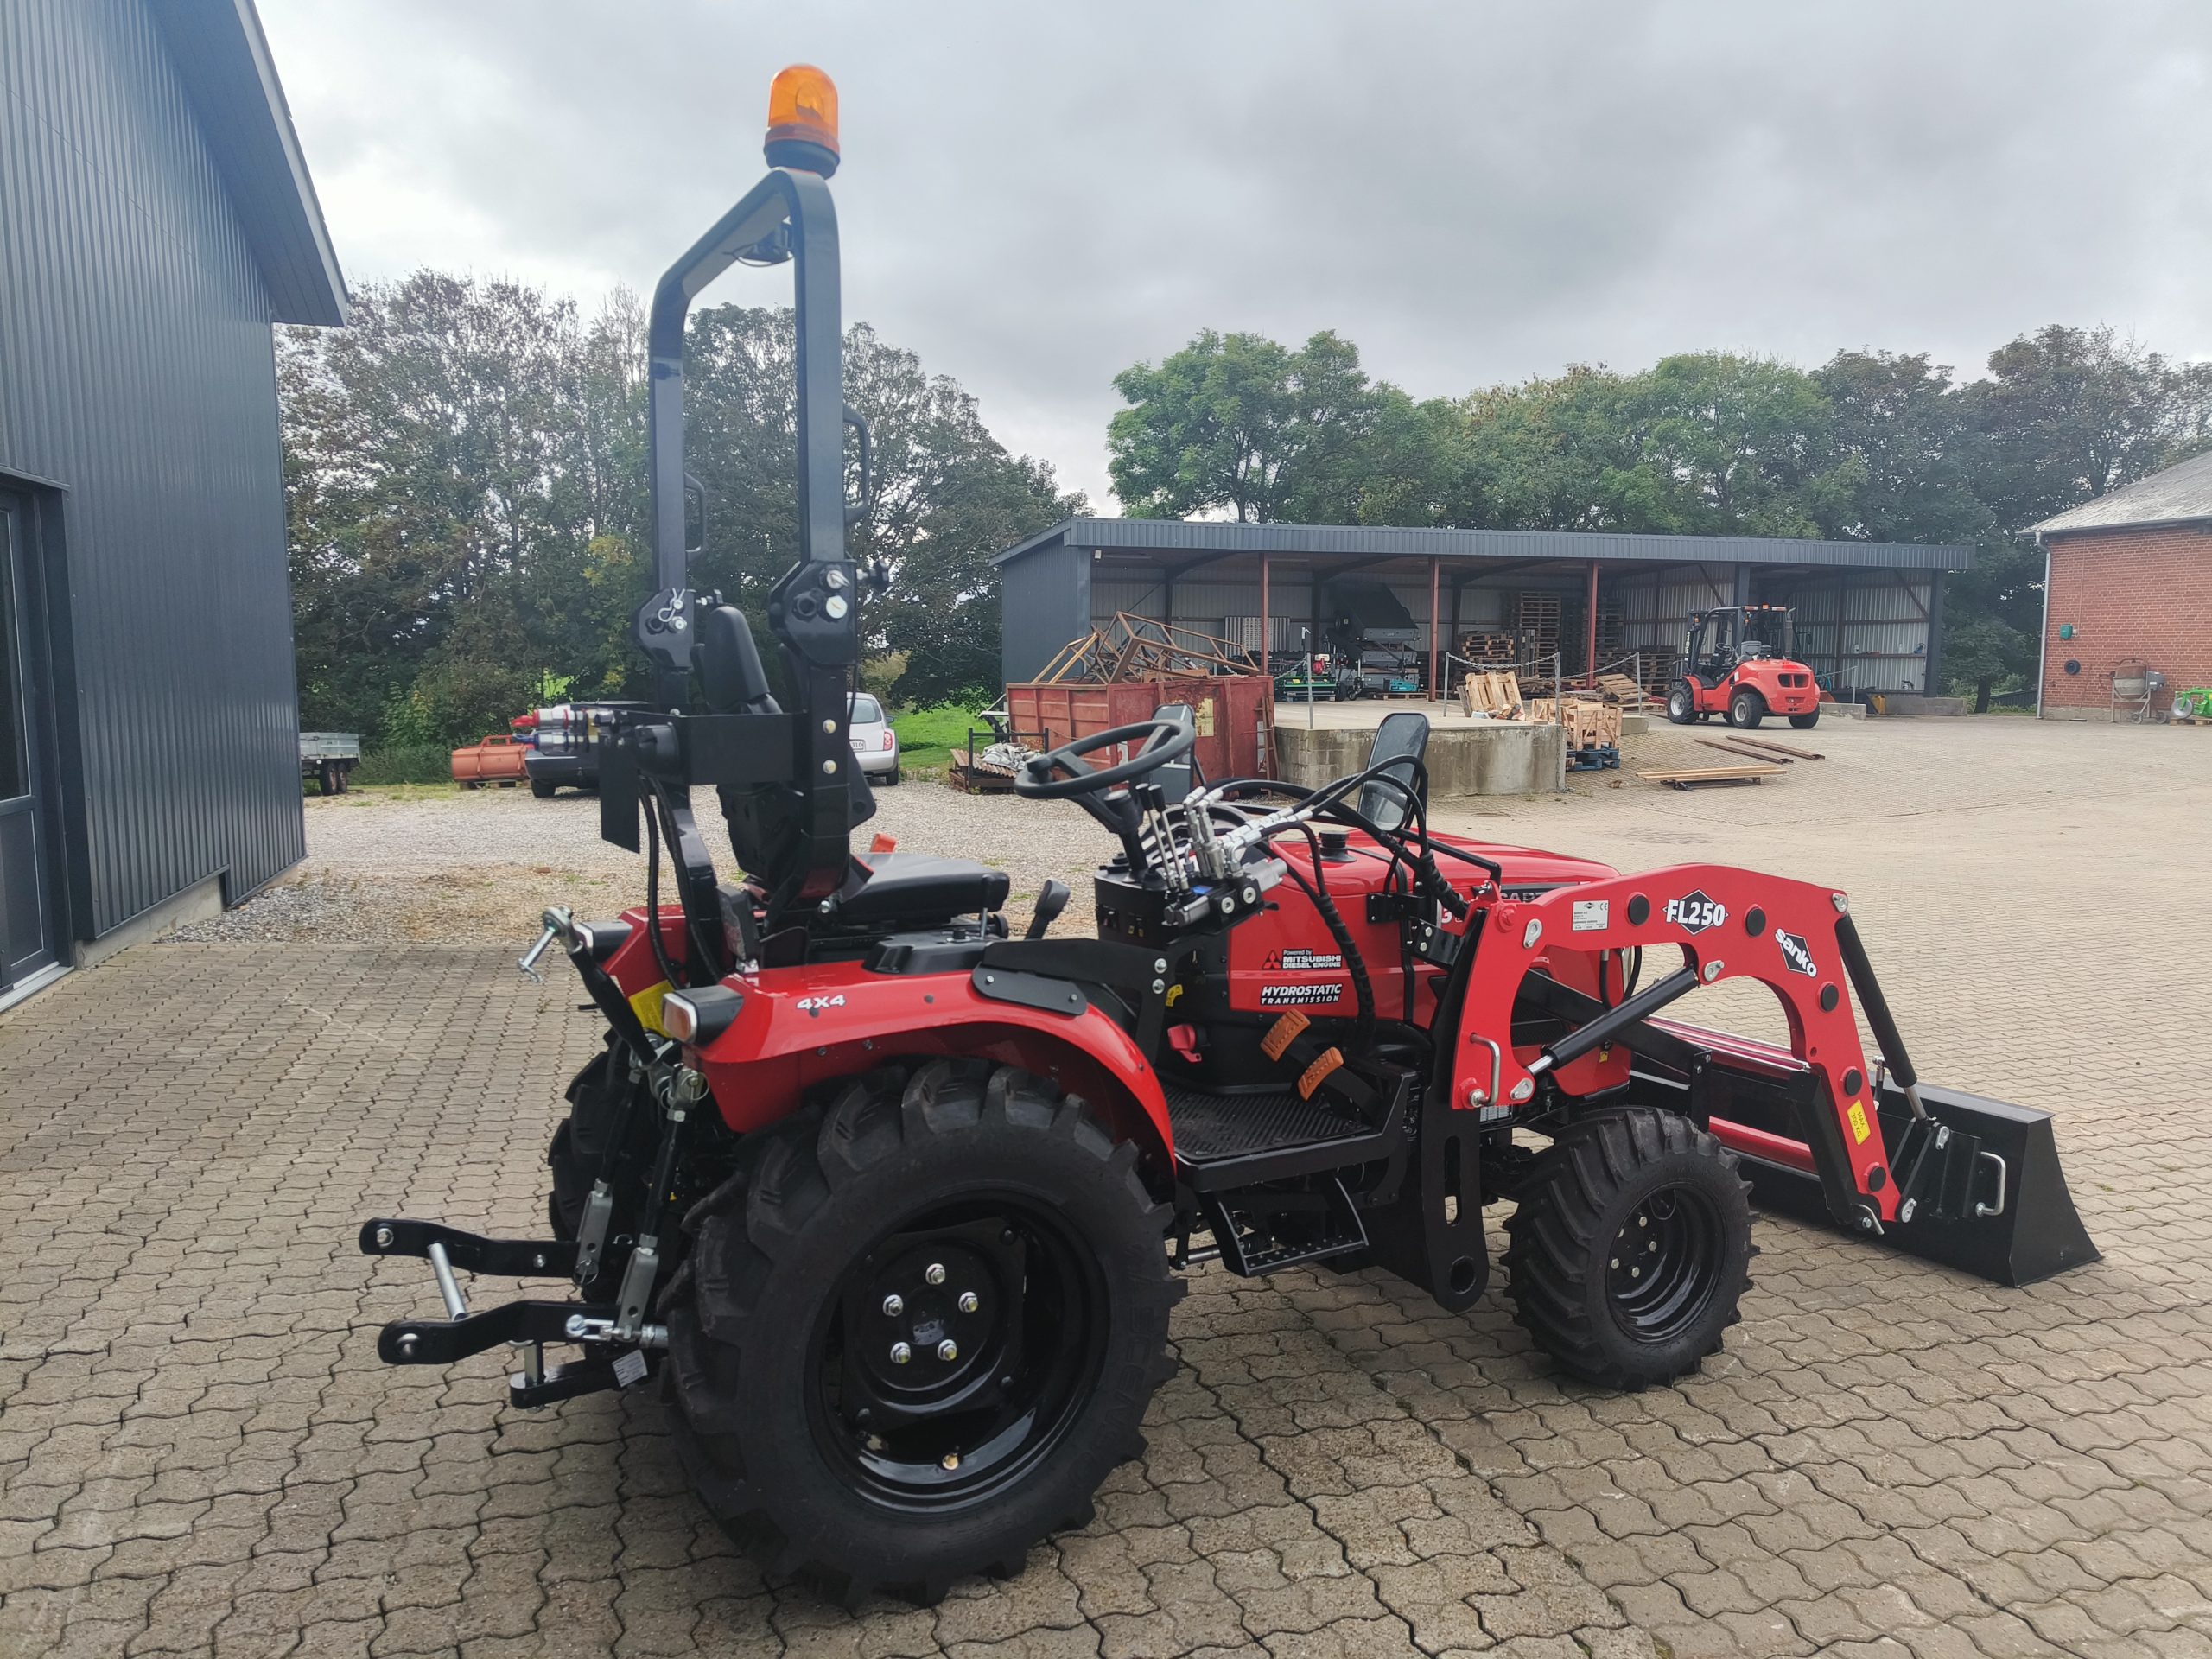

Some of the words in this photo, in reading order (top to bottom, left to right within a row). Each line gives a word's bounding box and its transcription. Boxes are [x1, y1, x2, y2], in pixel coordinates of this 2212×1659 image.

[1666, 899, 1726, 927] FL250
[1262, 984, 1343, 996] HYDROSTATIC
[1261, 995, 1339, 1005] TRANSMISSION
[1857, 1111, 1866, 1128] MAX
